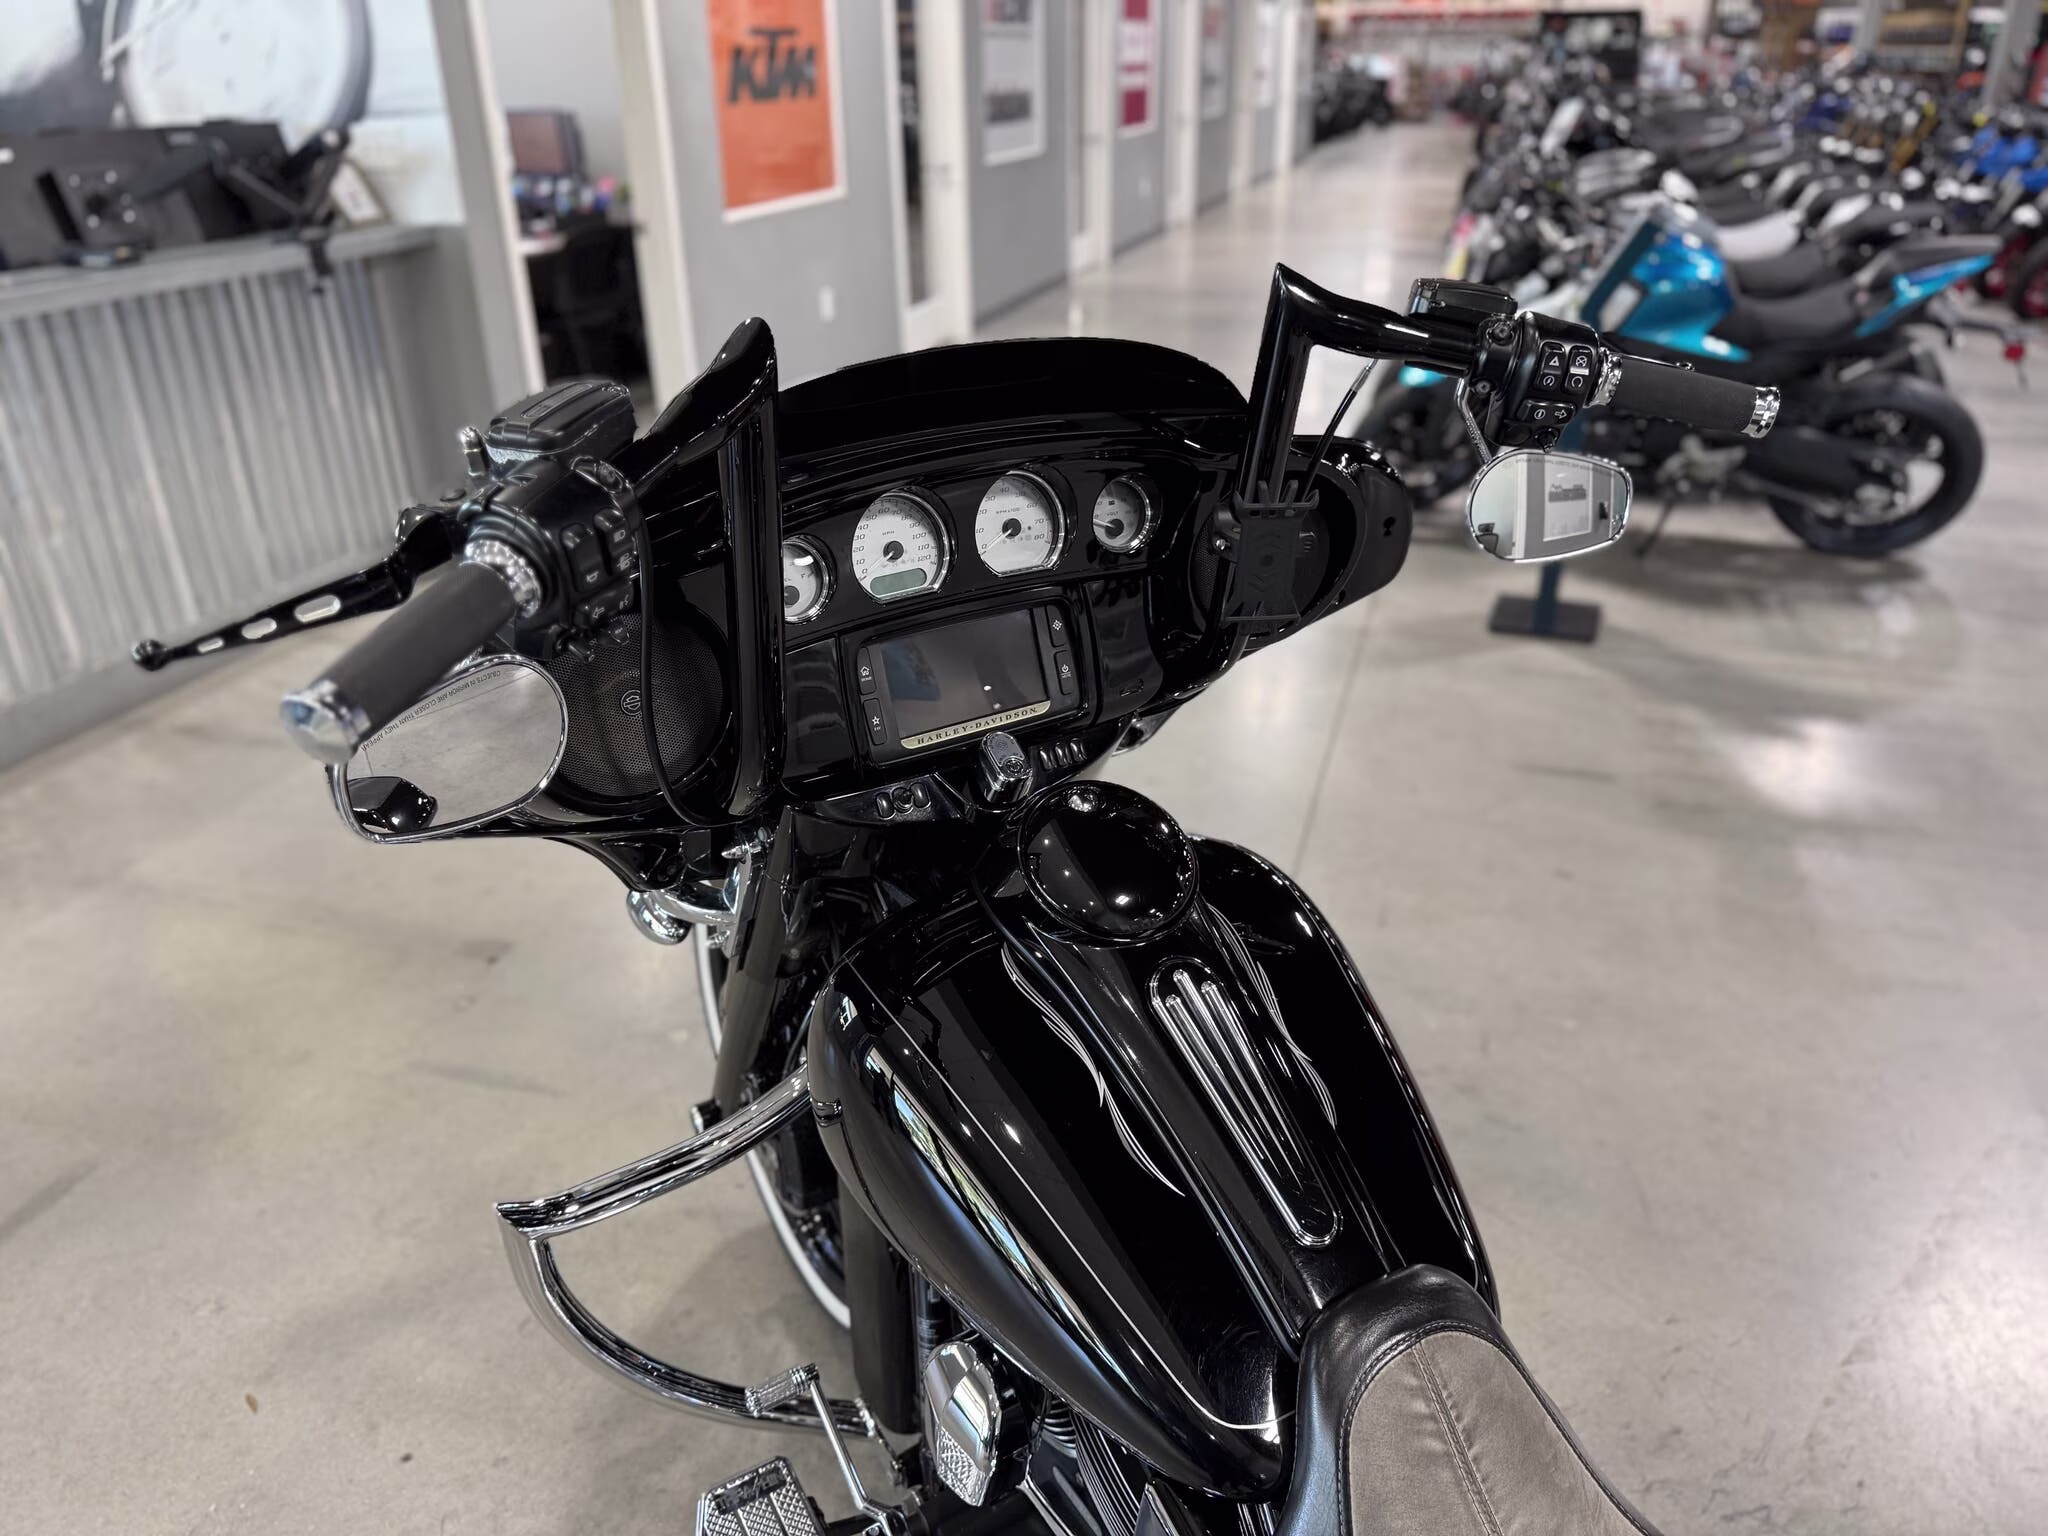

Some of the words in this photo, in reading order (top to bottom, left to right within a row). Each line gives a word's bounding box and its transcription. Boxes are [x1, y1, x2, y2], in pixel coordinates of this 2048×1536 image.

[727, 26, 817, 104] KTM
[912, 531, 927, 541] 100
[917, 543, 930, 551] 110
[917, 554, 931, 562] 120
[475, 670, 501, 684] OBJECTS
[448, 682, 470, 697] MIRROR
[436, 693, 448, 703] ARE
[414, 699, 437, 715] CLOSER
[399, 712, 415, 727] THAN
[917, 706, 1038, 745] HARLEY-DAVIDSON
[384, 723, 399, 736] THEY
[361, 732, 384, 752] APPEAR
